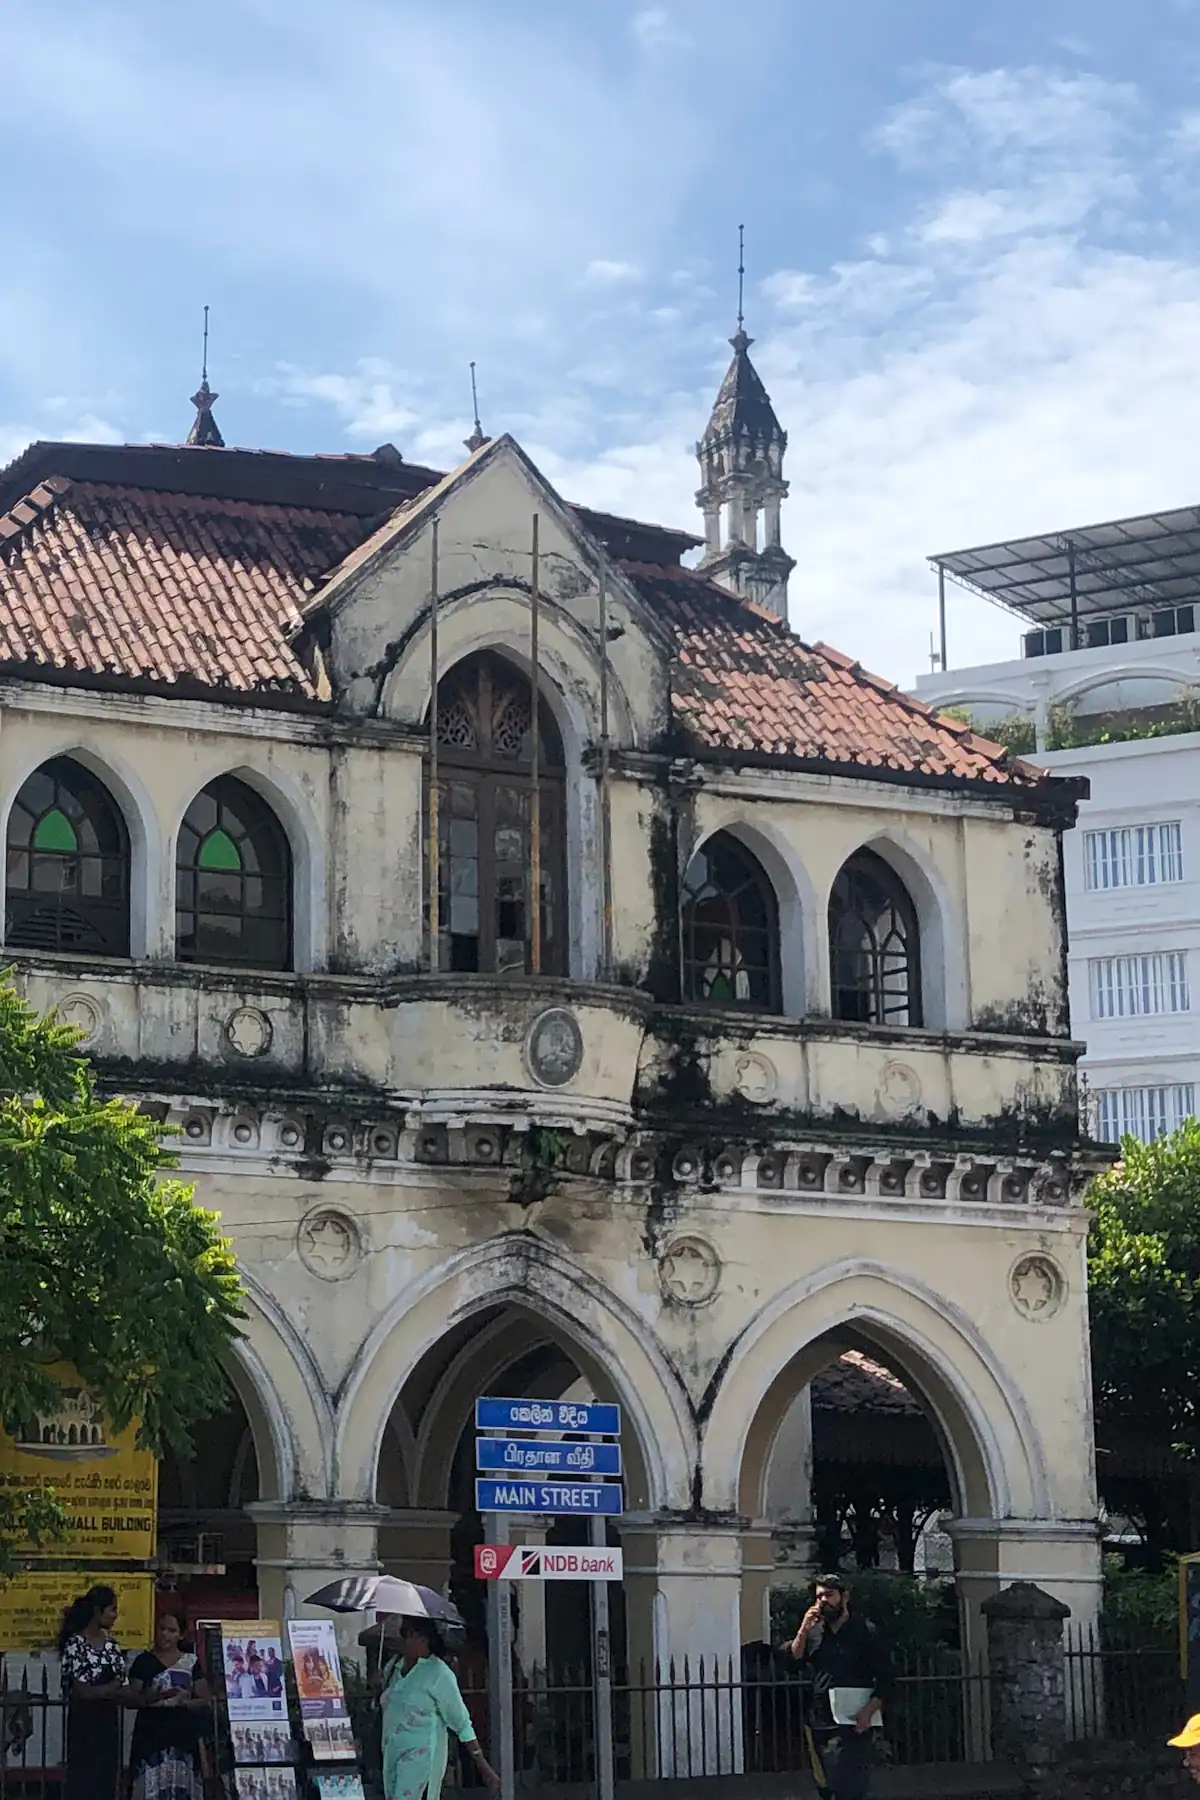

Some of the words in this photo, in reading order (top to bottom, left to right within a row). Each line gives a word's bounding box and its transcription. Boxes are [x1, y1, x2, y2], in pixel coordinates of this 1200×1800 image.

[504, 1443, 562, 1467] பிரதான
[566, 1446, 594, 1469] வீதி
[494, 1486, 536, 1505] MAIN
[541, 1487, 602, 1507] STREET
[102, 1516, 151, 1531] BUILDING
[543, 1555, 578, 1572] NDB
[580, 1556, 615, 1572] bank
